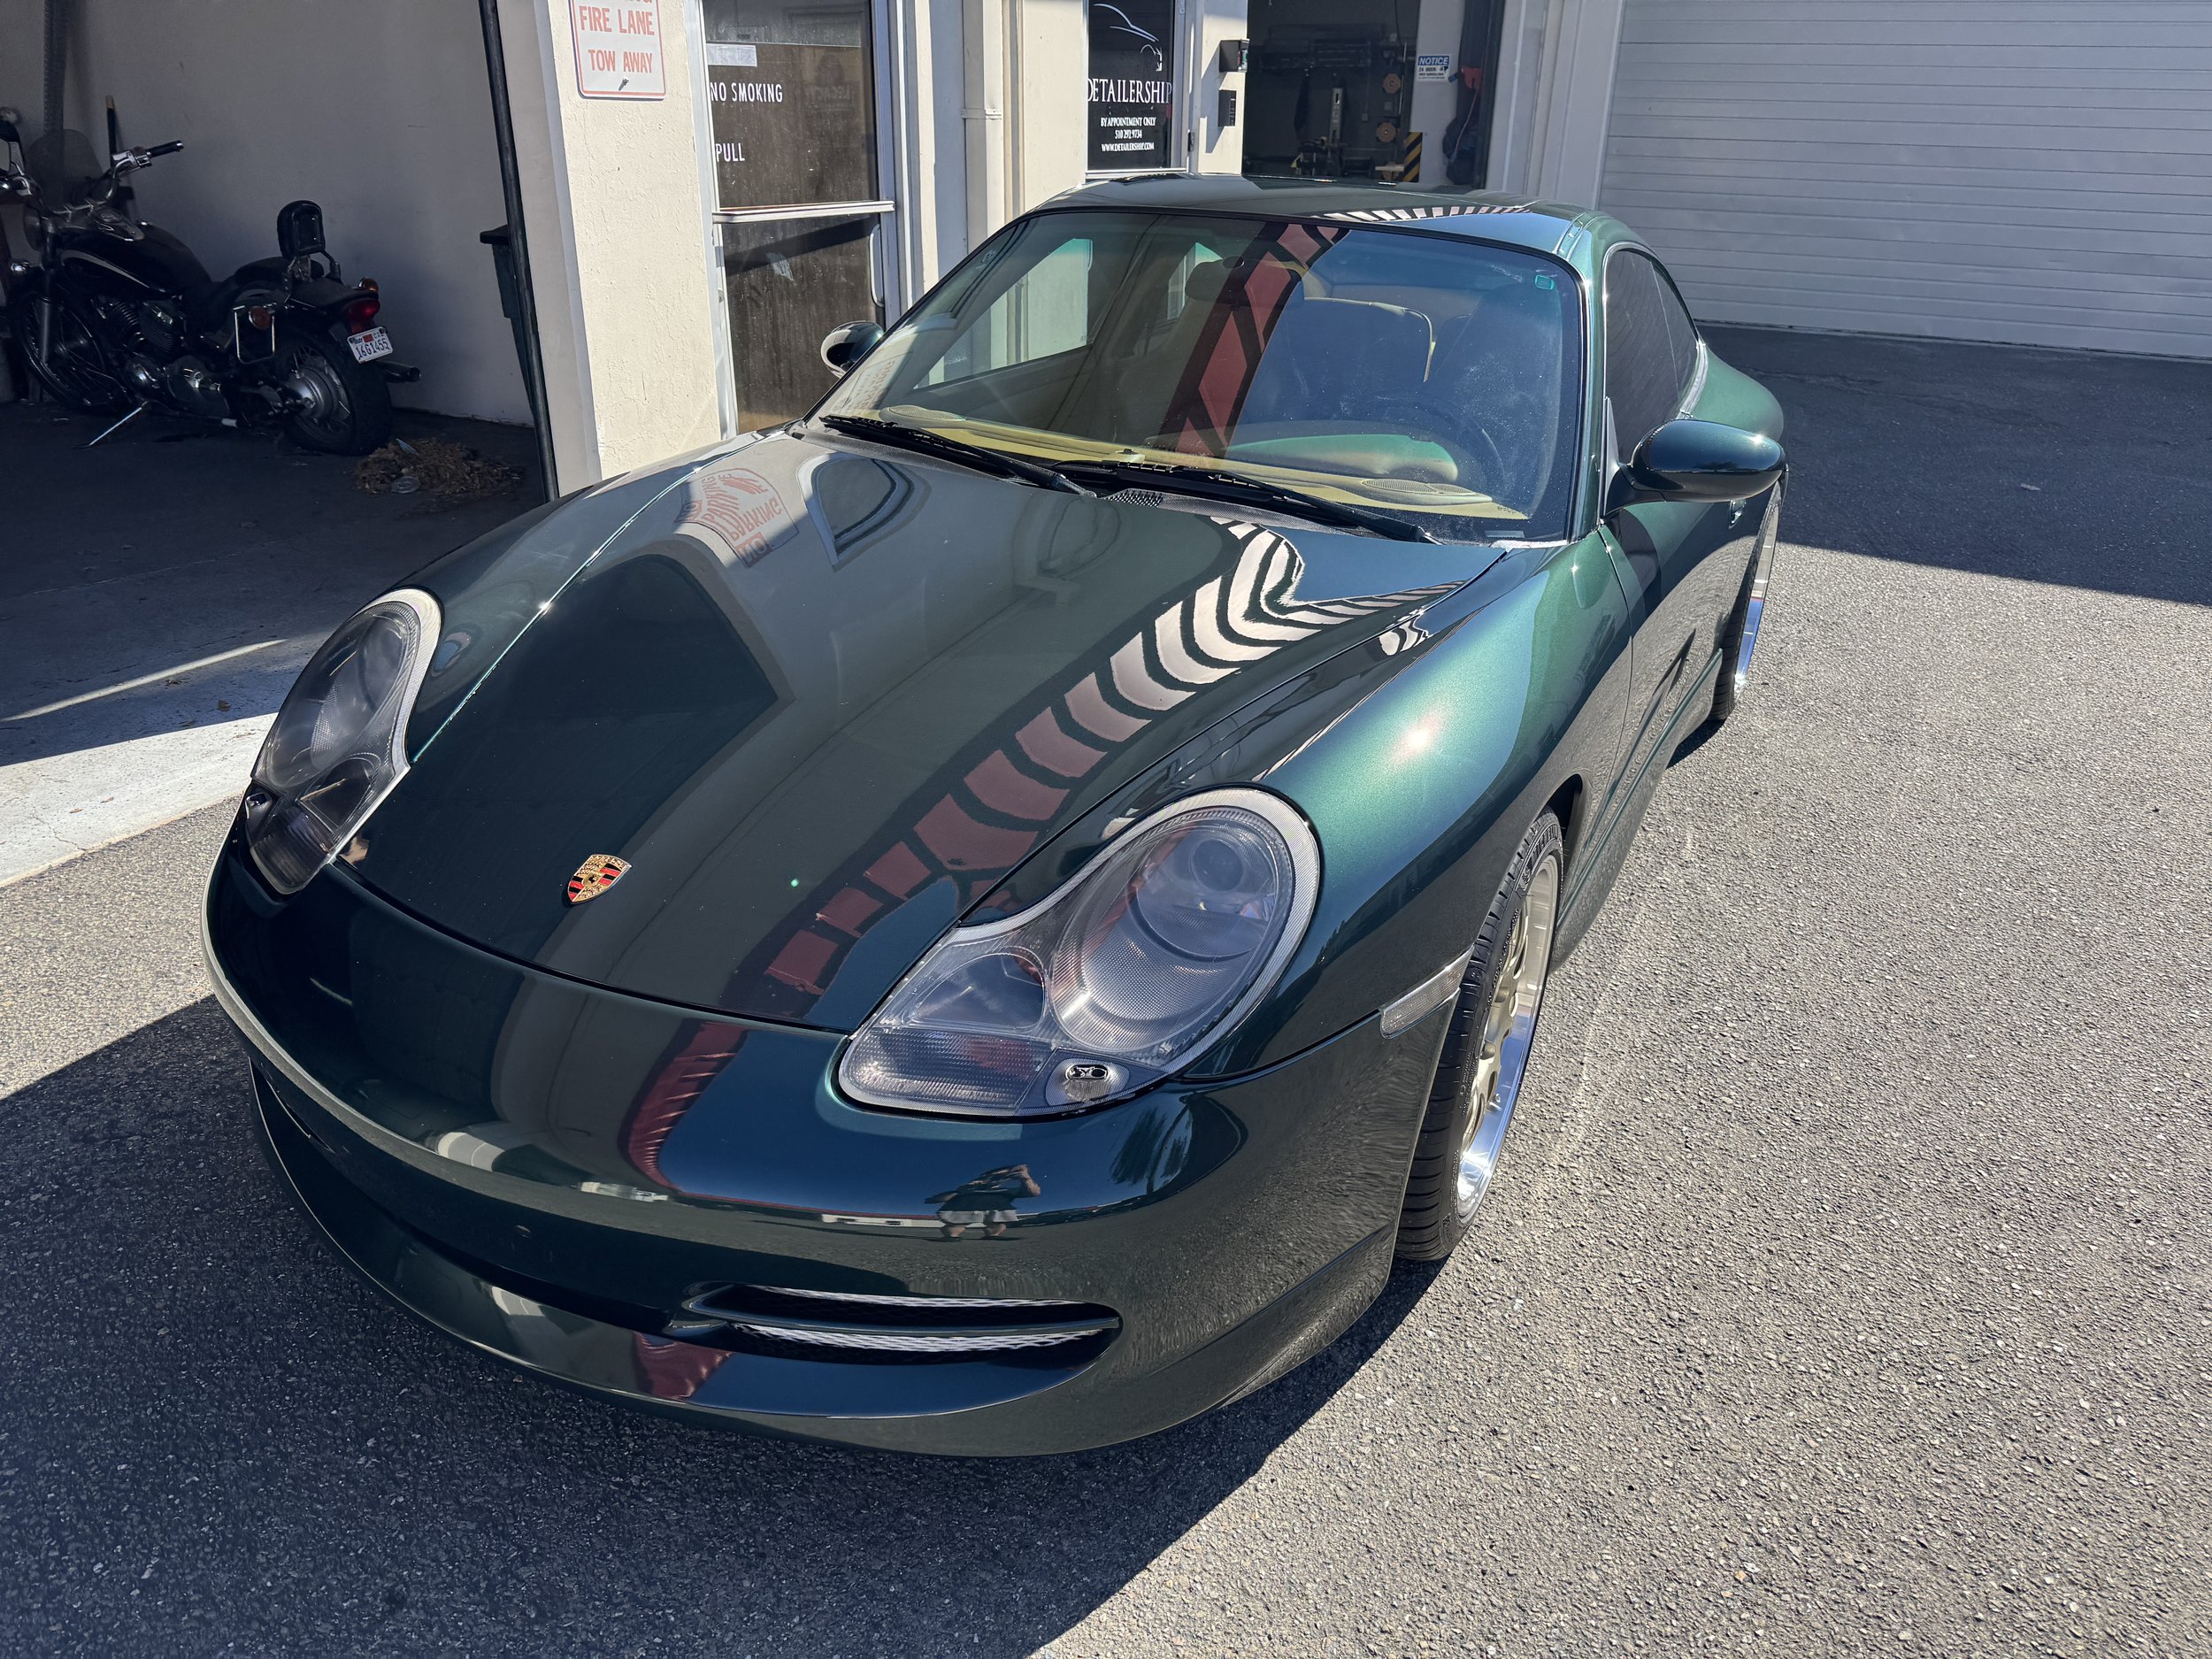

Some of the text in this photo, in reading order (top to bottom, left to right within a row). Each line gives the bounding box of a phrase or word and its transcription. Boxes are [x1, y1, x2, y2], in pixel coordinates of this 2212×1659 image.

[579, 5, 655, 35] FIRE LANE
[588, 49, 652, 73] TOW AWAY
[710, 81, 783, 103] NO SMOKING
[1087, 78, 1172, 104] DETAILERSHIP
[1101, 117, 1156, 127] BY APPOINTMENT ONLY
[715, 142, 745, 163] PULL
